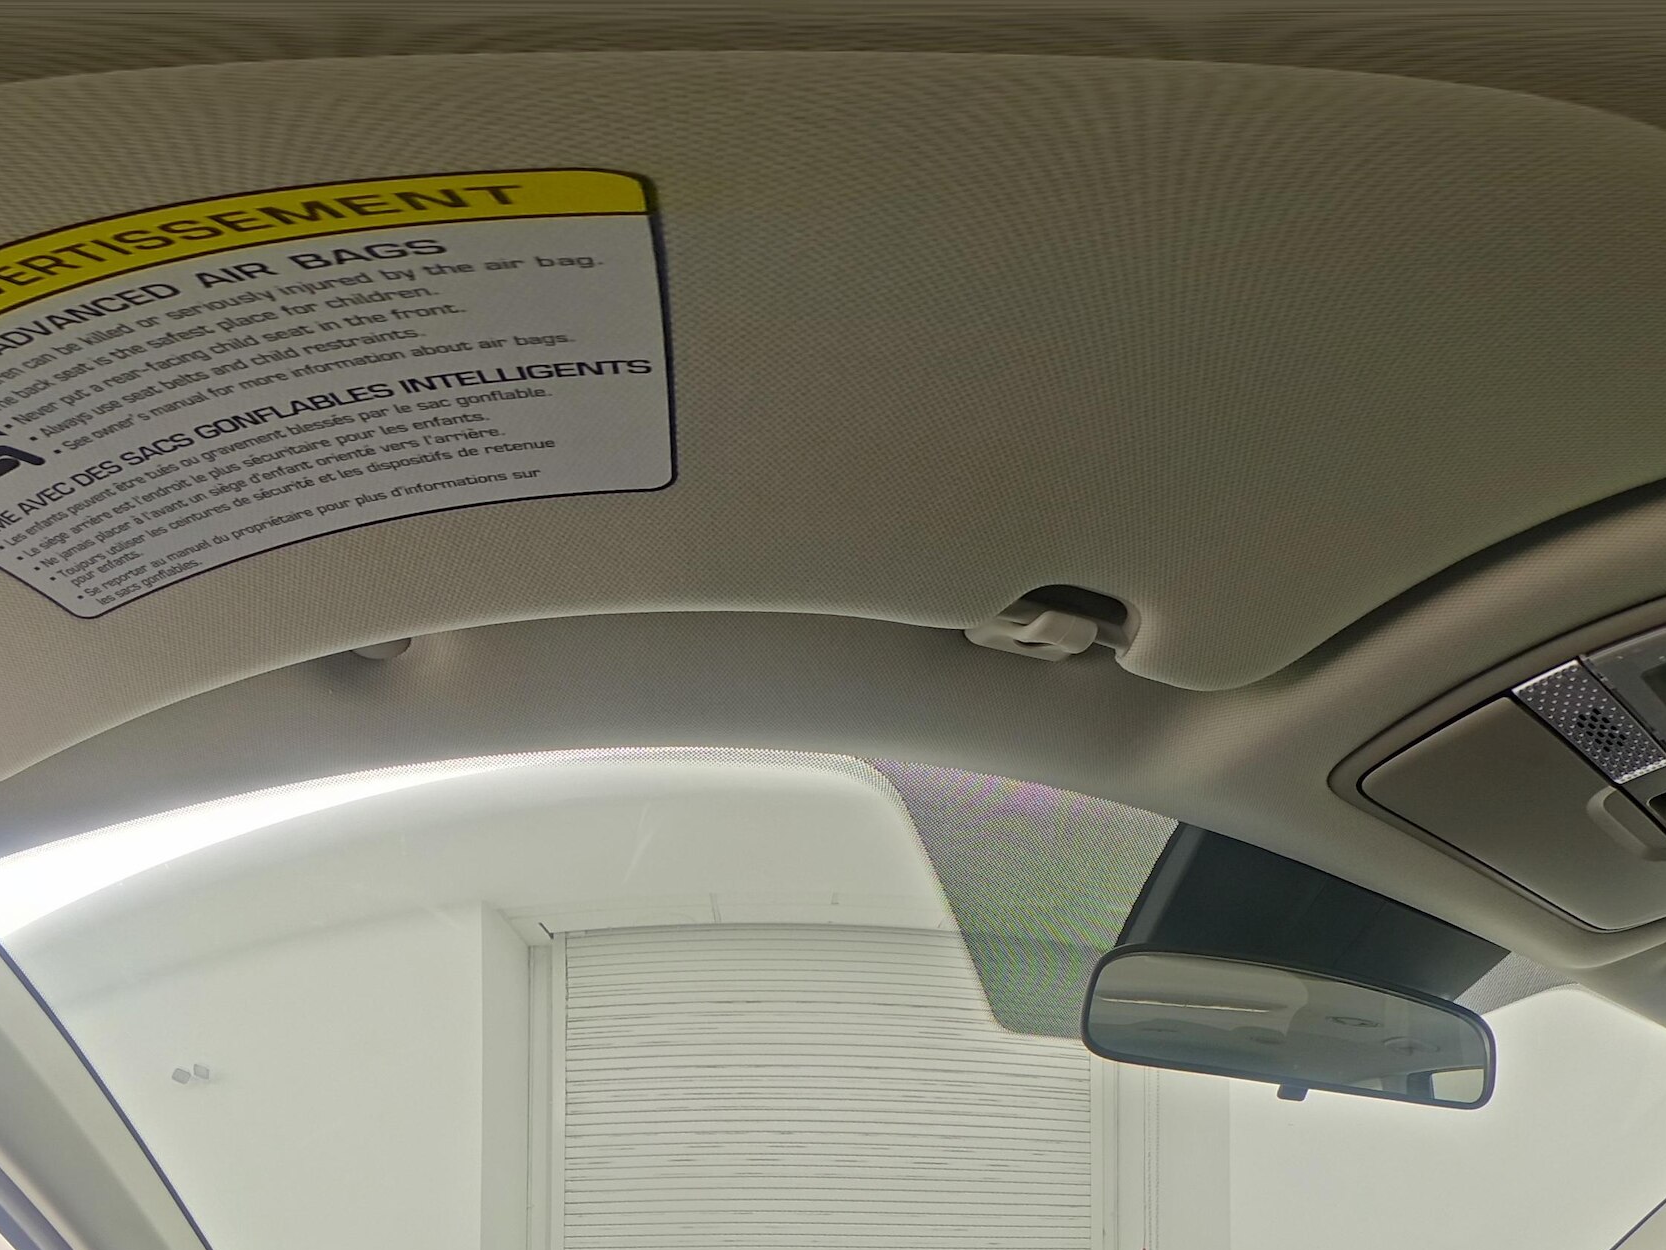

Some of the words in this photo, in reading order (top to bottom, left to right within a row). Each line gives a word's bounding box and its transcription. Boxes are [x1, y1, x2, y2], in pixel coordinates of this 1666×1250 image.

[22, 354, 58, 369] can
[50, 343, 83, 355] be
[76, 323, 136, 345] killed
[135, 316, 160, 328] or
[165, 291, 276, 320] seriously
[275, 272, 375, 295] injured
[378, 269, 416, 281] by
[421, 264, 475, 275] the
[484, 259, 525, 270] air
[534, 256, 603, 268] bag.
[195, 263, 279, 288] AIR
[287, 240, 447, 270] BAGS
[10, 379, 56, 398] back
[52, 363, 95, 382] seat
[88, 357, 113, 366] is
[109, 345, 148, 359] the
[146, 326, 215, 348] safest
[216, 312, 279, 333] place
[280, 303, 318, 316] for
[325, 288, 439, 308] children.
[11, 402, 58, 425] Never
[59, 390, 91, 406] put
[89, 384, 105, 392] a
[102, 350, 212, 387] rear-facing
[208, 335, 261, 354] child
[261, 326, 315, 342] seat
[315, 321, 342, 331] in
[342, 314, 388, 326] the
[389, 305, 466, 320] front.
[39, 412, 93, 438] Always
[91, 401, 123, 415] use
[121, 386, 163, 403] seat
[158, 372, 210, 390] belts
[210, 359, 249, 375] and
[250, 347, 301, 365] child
[302, 330, 426, 354] restraints.
[17, 482, 75, 515] AVEC
[69, 461, 123, 487] DES
[119, 433, 195, 465] SACS
[194, 384, 395, 439] GONFLABLES
[398, 360, 652, 394] INTELLIGENTS
